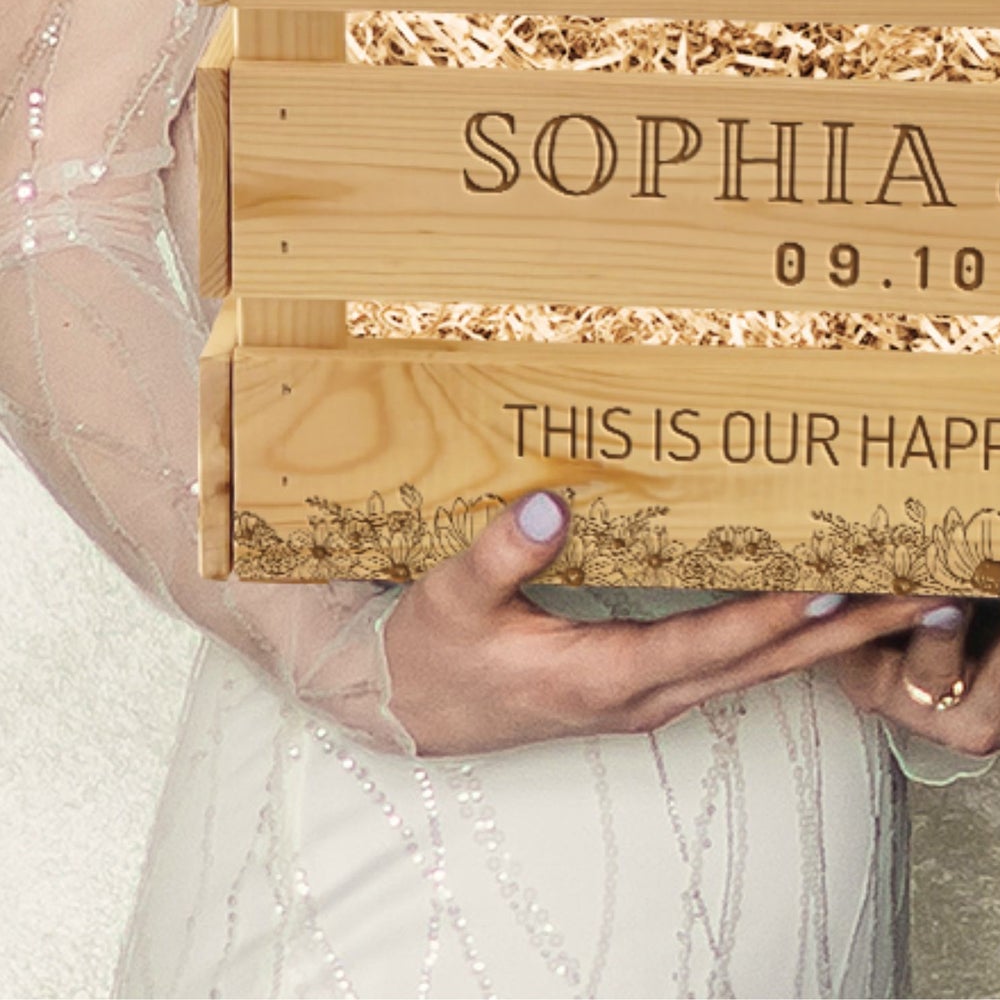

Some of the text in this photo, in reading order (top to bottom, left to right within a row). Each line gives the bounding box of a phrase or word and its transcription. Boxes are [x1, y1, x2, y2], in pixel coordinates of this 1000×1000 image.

[462, 110, 958, 208] SOPHIA
[502, 403, 633, 460] THIS
[654, 408, 702, 462] IS
[722, 410, 840, 467] OUR
